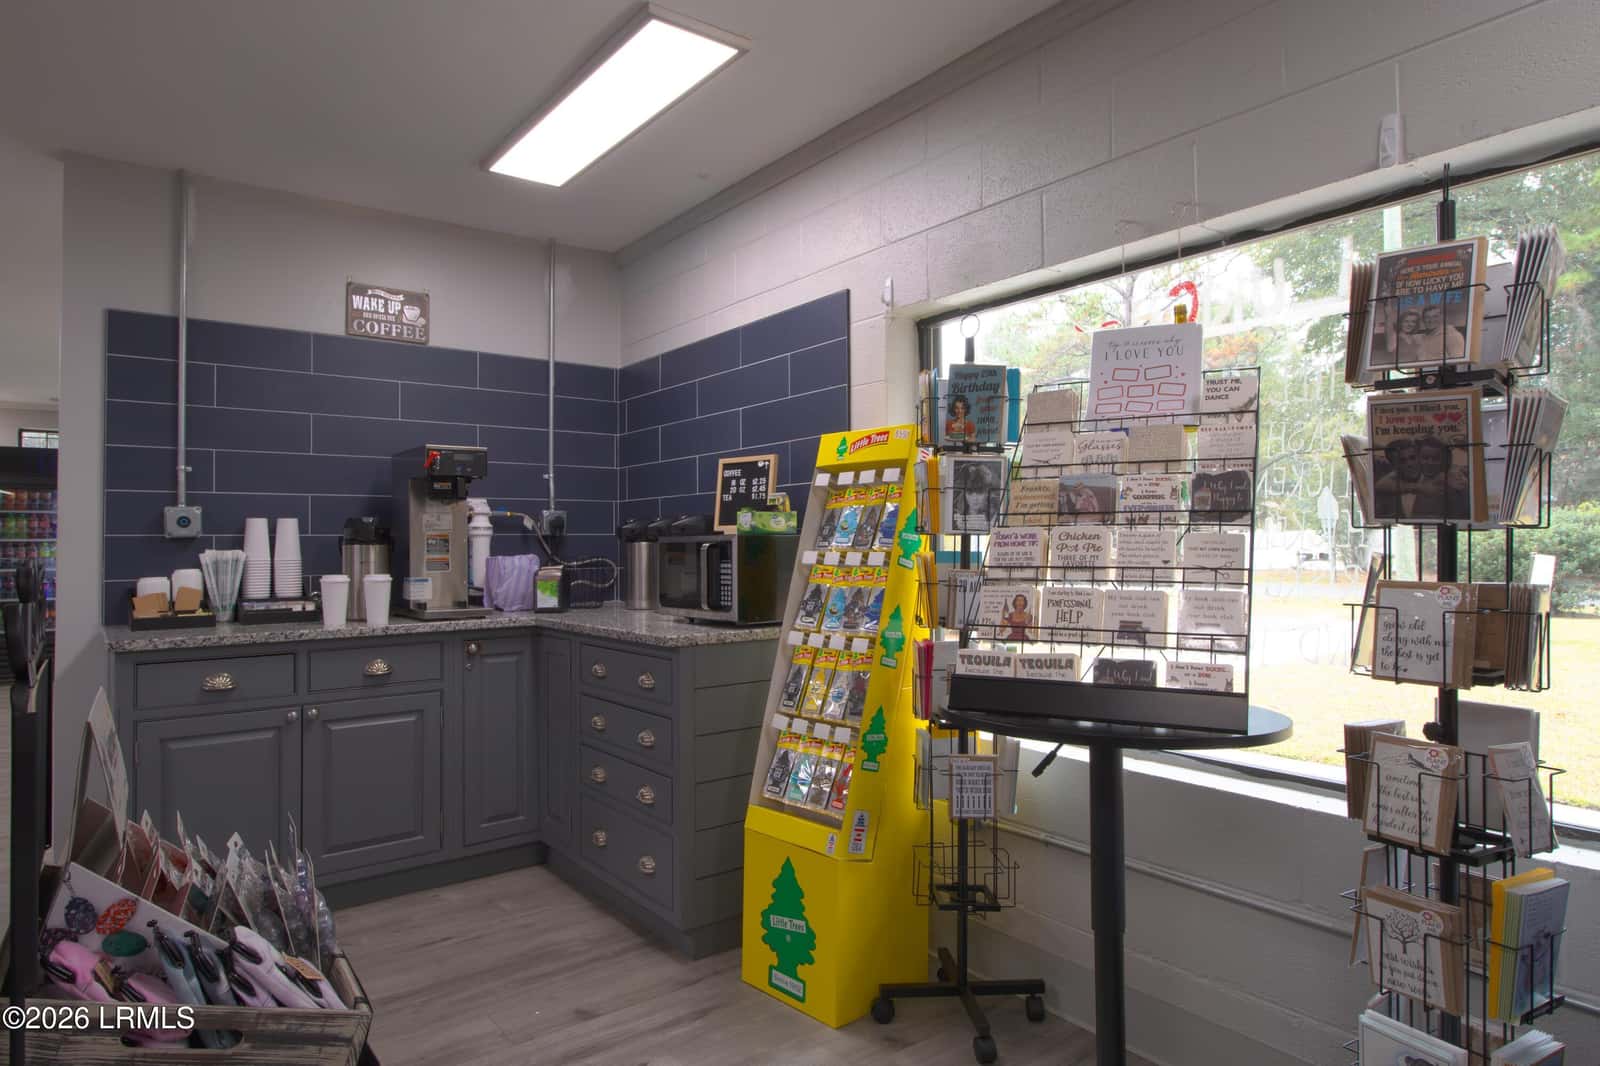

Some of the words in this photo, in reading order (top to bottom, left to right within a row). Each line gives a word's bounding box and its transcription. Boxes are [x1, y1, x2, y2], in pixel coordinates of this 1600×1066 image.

[1423, 275, 1447, 285] LUCKY
[1449, 272, 1464, 280] YOU
[1426, 283, 1448, 292] HAVE
[1451, 280, 1465, 288] ME
[352, 294, 384, 313] WAKE
[388, 301, 402, 315] UP
[353, 319, 426, 340] COFFEE
[1116, 347, 1149, 361] LOVE
[1158, 345, 1184, 358] YOU
[951, 382, 1001, 394] Birthday
[1386, 416, 1405, 424] love
[1393, 424, 1435, 435] keeping
[851, 439, 870, 453] Little
[724, 469, 742, 478] COFFEE
[995, 531, 1019, 541] TODAY'S
[1059, 531, 1102, 542] Chicken
[1056, 543, 1080, 553] Pot
[1082, 543, 1104, 553] Pie
[1058, 554, 1076, 562] THREE
[1047, 599, 1095, 609] PROFESSIONAL
[1056, 609, 1084, 624] HELP
[1410, 635, 1432, 647] with
[960, 654, 1012, 668] TEQUILA
[1381, 647, 1393, 658] the
[1426, 651, 1441, 665] yet
[1019, 657, 1074, 670] TEQUILA
[1380, 661, 1391, 672] to
[772, 917, 787, 929] Little
[788, 919, 805, 932] Trees
